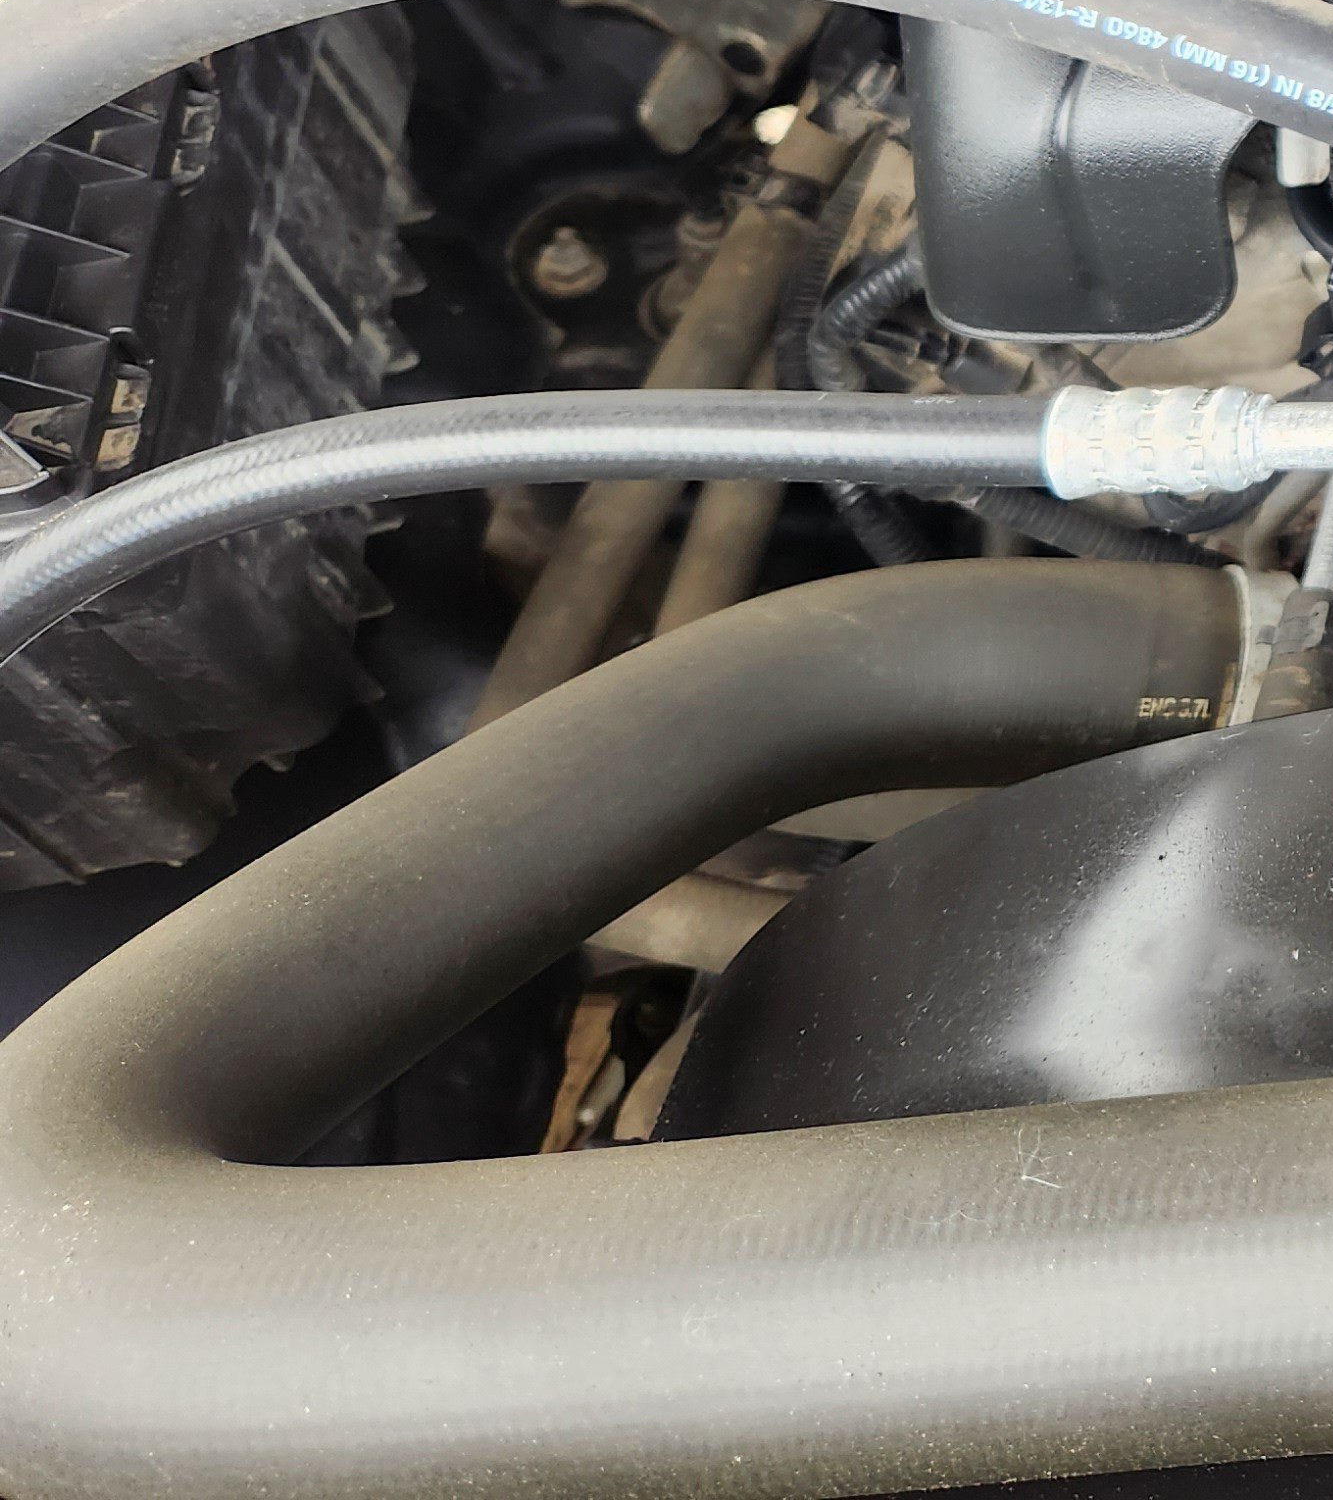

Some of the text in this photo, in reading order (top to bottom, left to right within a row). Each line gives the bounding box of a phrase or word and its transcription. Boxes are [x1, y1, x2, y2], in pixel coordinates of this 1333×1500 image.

[1102, 16, 1169, 50] 4860
[1170, 34, 1228, 72] MM)
[1227, 60, 1271, 88] (16
[1270, 74, 1304, 100] IN
